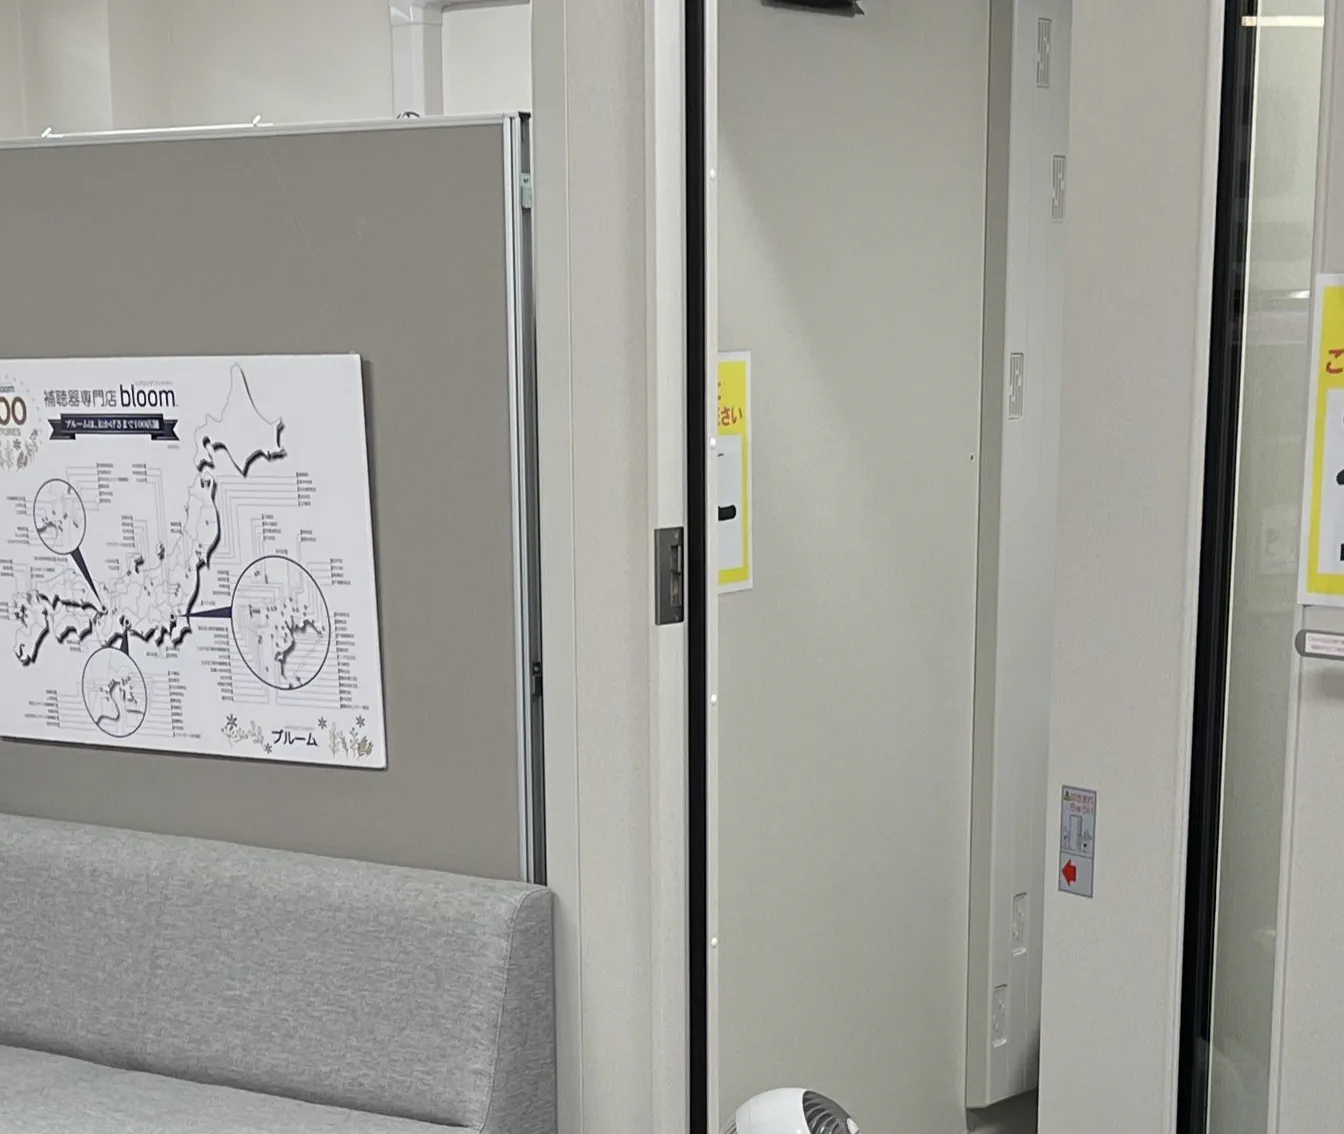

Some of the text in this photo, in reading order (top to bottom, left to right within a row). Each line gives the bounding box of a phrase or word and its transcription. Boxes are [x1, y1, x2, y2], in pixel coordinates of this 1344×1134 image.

[44, 384, 176, 407] 補聴器専門店 bloom
[271, 729, 319, 747] ブルーム
